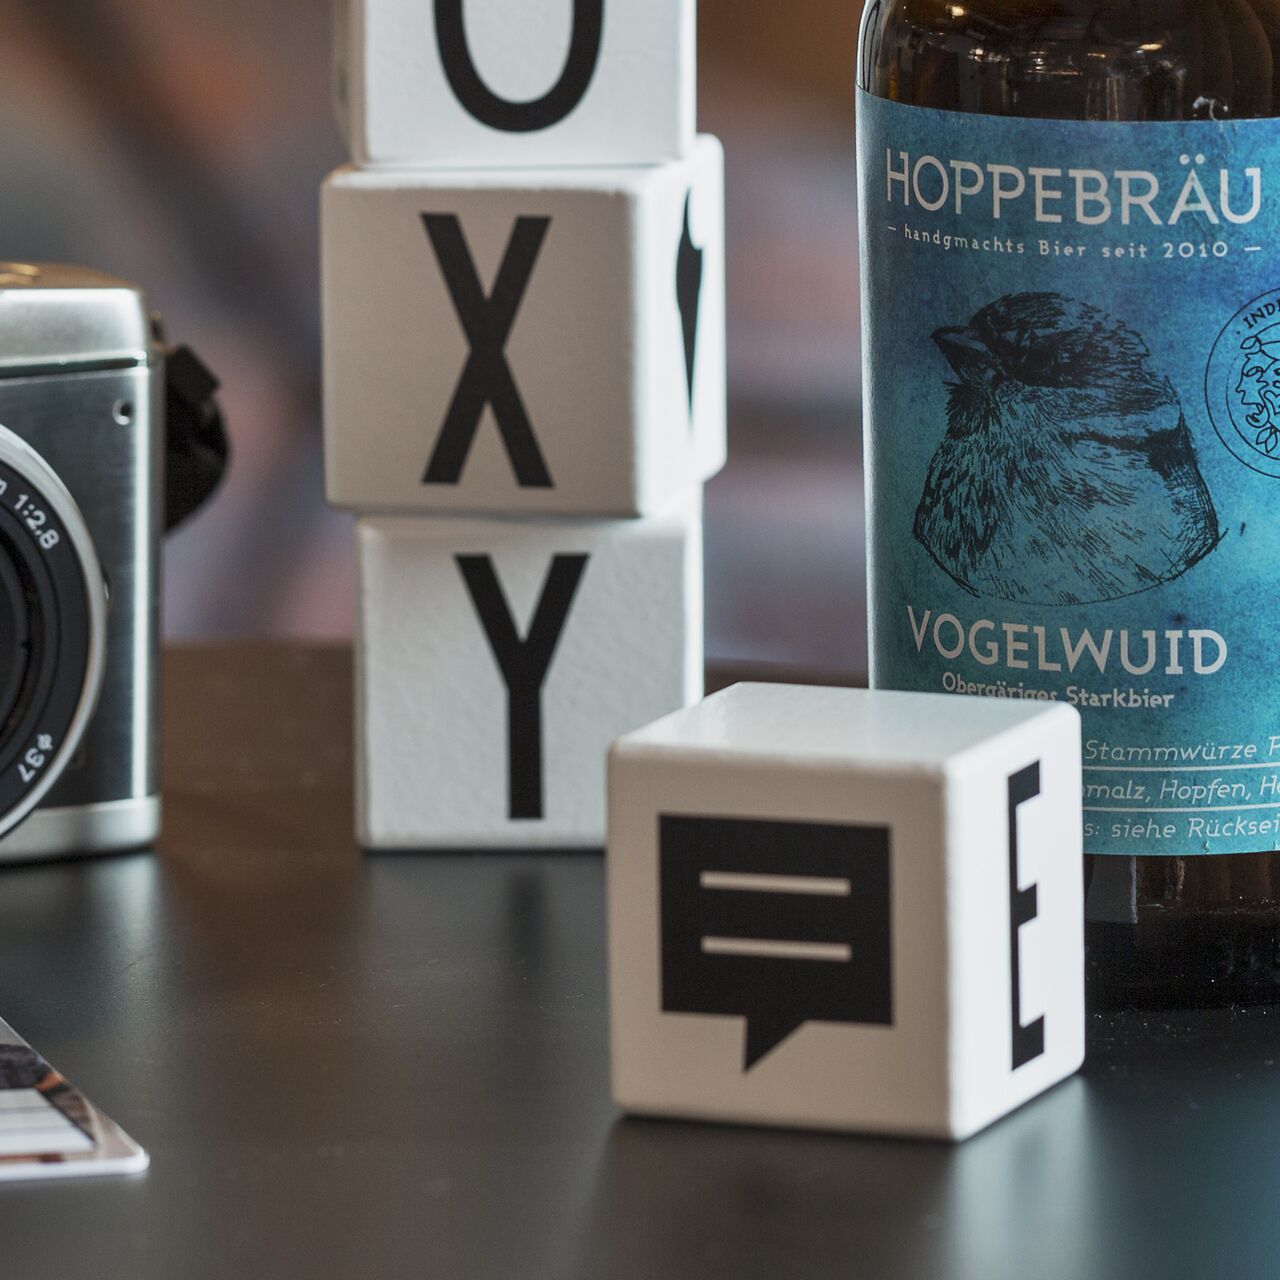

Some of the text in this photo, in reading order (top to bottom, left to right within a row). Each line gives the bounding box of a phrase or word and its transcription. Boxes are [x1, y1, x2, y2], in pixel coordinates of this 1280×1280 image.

[885, 147, 1262, 226] HOPPEBRÄU
[903, 223, 1229, 259] handgmachts Bier seit 2010
[906, 605, 1228, 675] VOGELWUID
[1066, 685, 1175, 709] Starkbier
[1084, 739, 1257, 761] Stammwürze
[1082, 779, 1152, 804] malz,
[1159, 778, 1253, 805] Hopfen,
[1111, 818, 1177, 839] siehe
